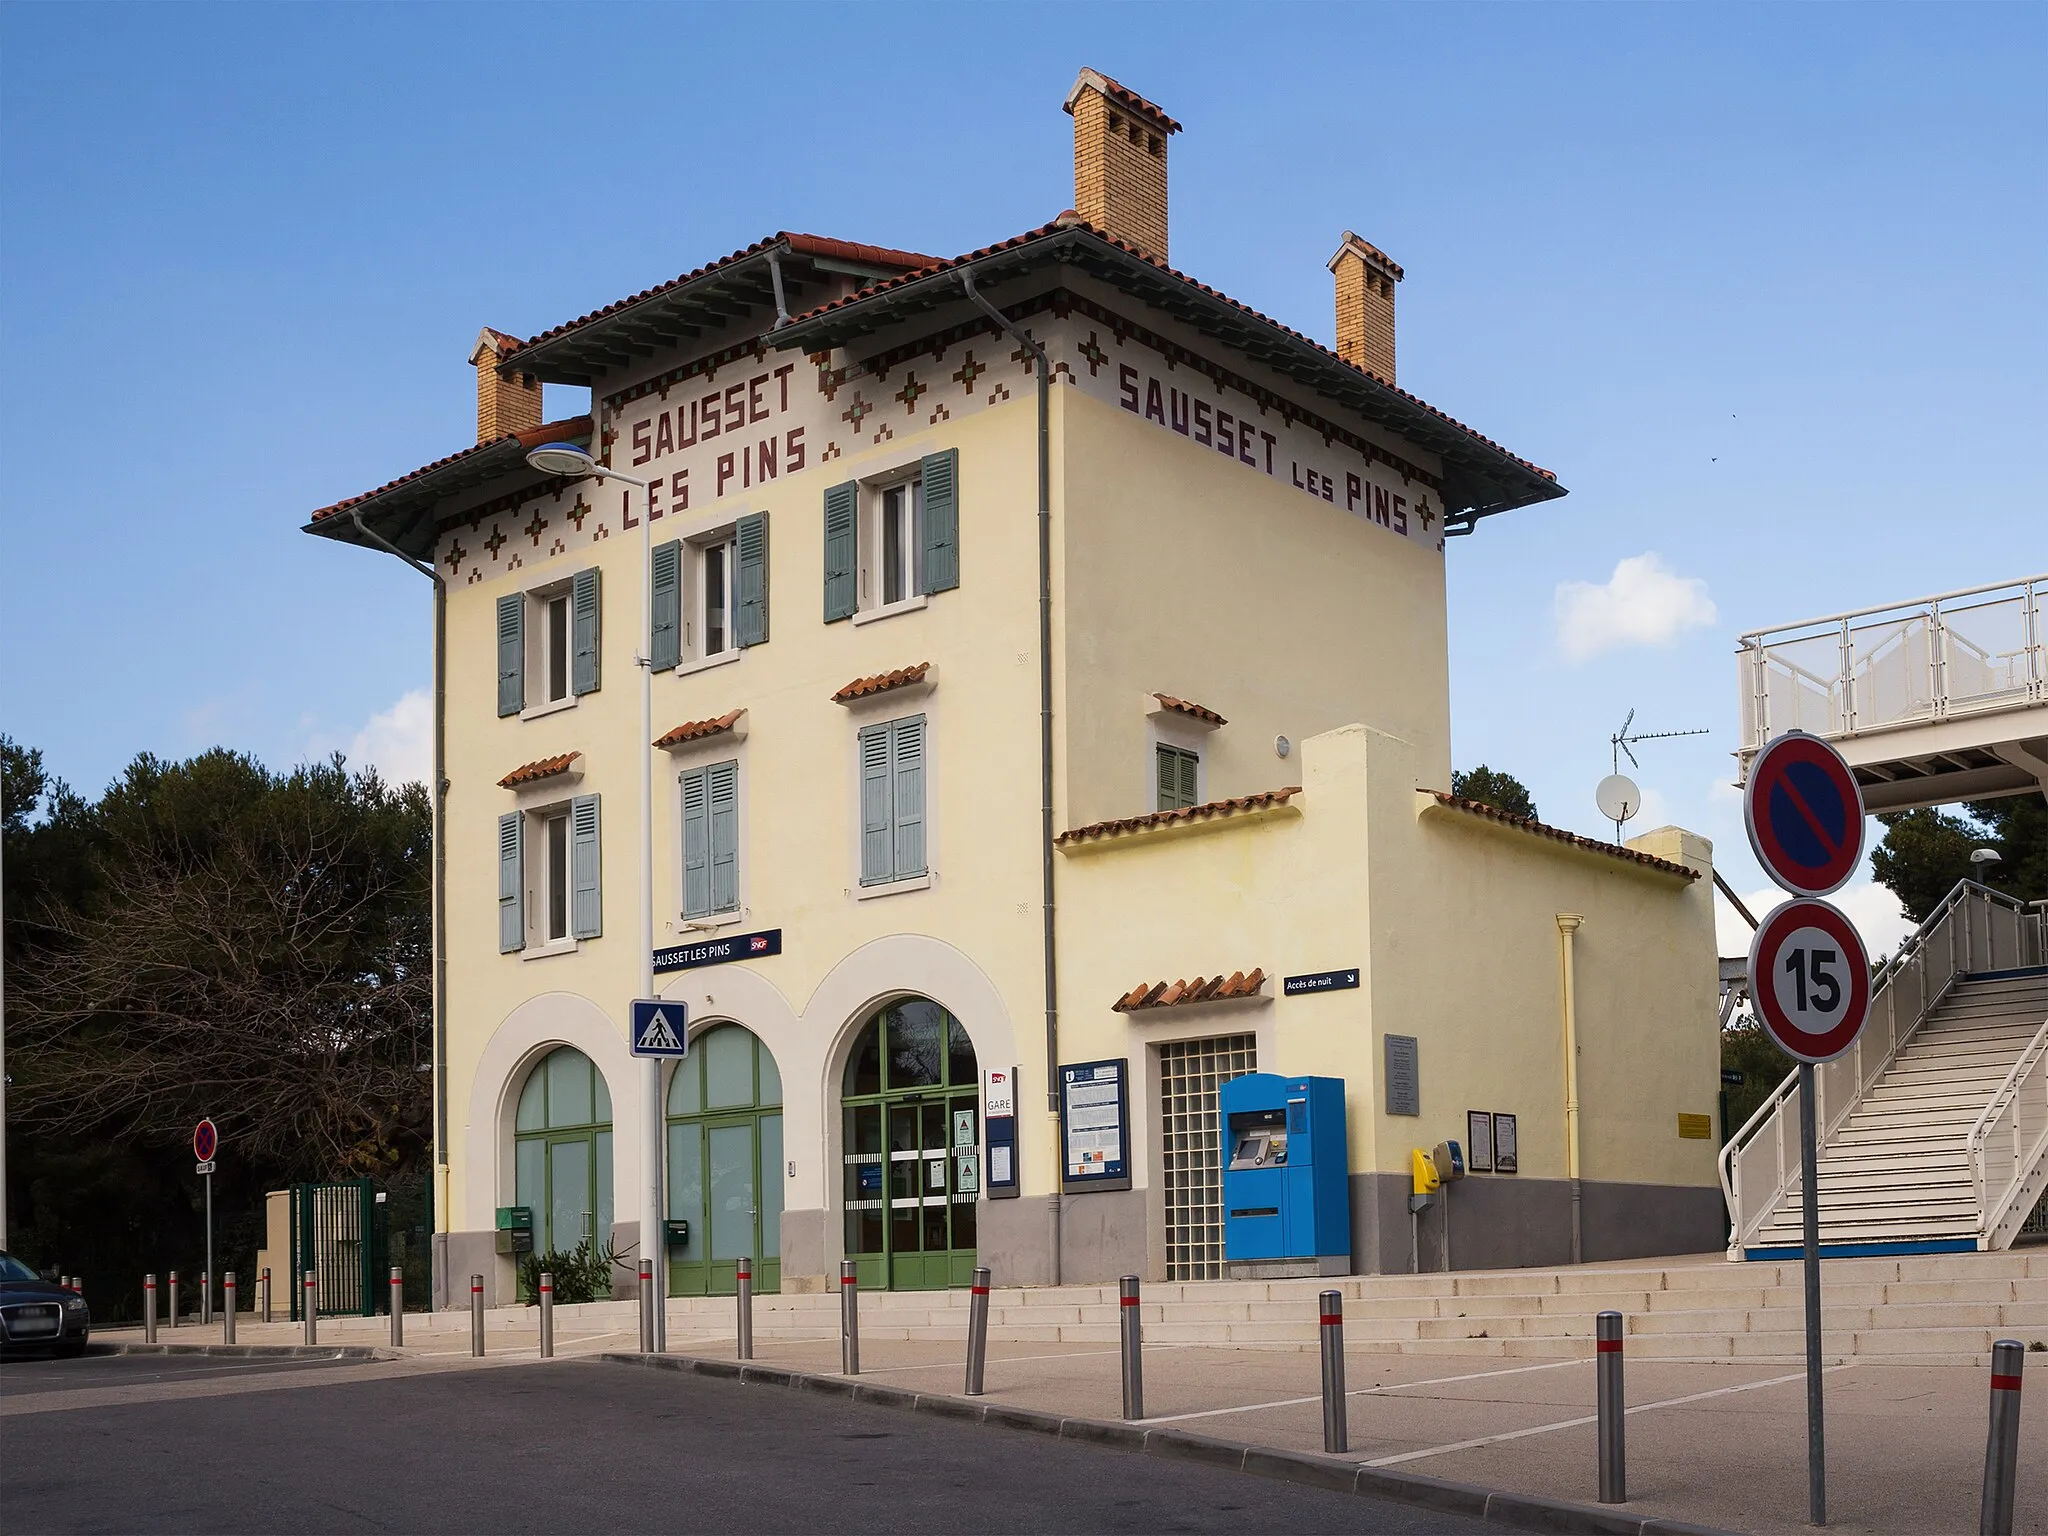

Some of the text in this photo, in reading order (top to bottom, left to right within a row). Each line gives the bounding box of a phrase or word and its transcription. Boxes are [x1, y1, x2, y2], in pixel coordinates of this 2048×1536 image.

[632, 362, 794, 467] SAUSSET
[1119, 362, 1408, 536] SAUSSET LES PINS
[623, 426, 805, 531] LES PINS
[690, 947, 707, 961] LES
[709, 943, 731, 957] PINS
[750, 939, 768, 950] SNCF
[1286, 977, 1332, 990] Accès de nuit
[1785, 948, 1841, 1013] 15
[988, 1099, 1011, 1110] GARE
